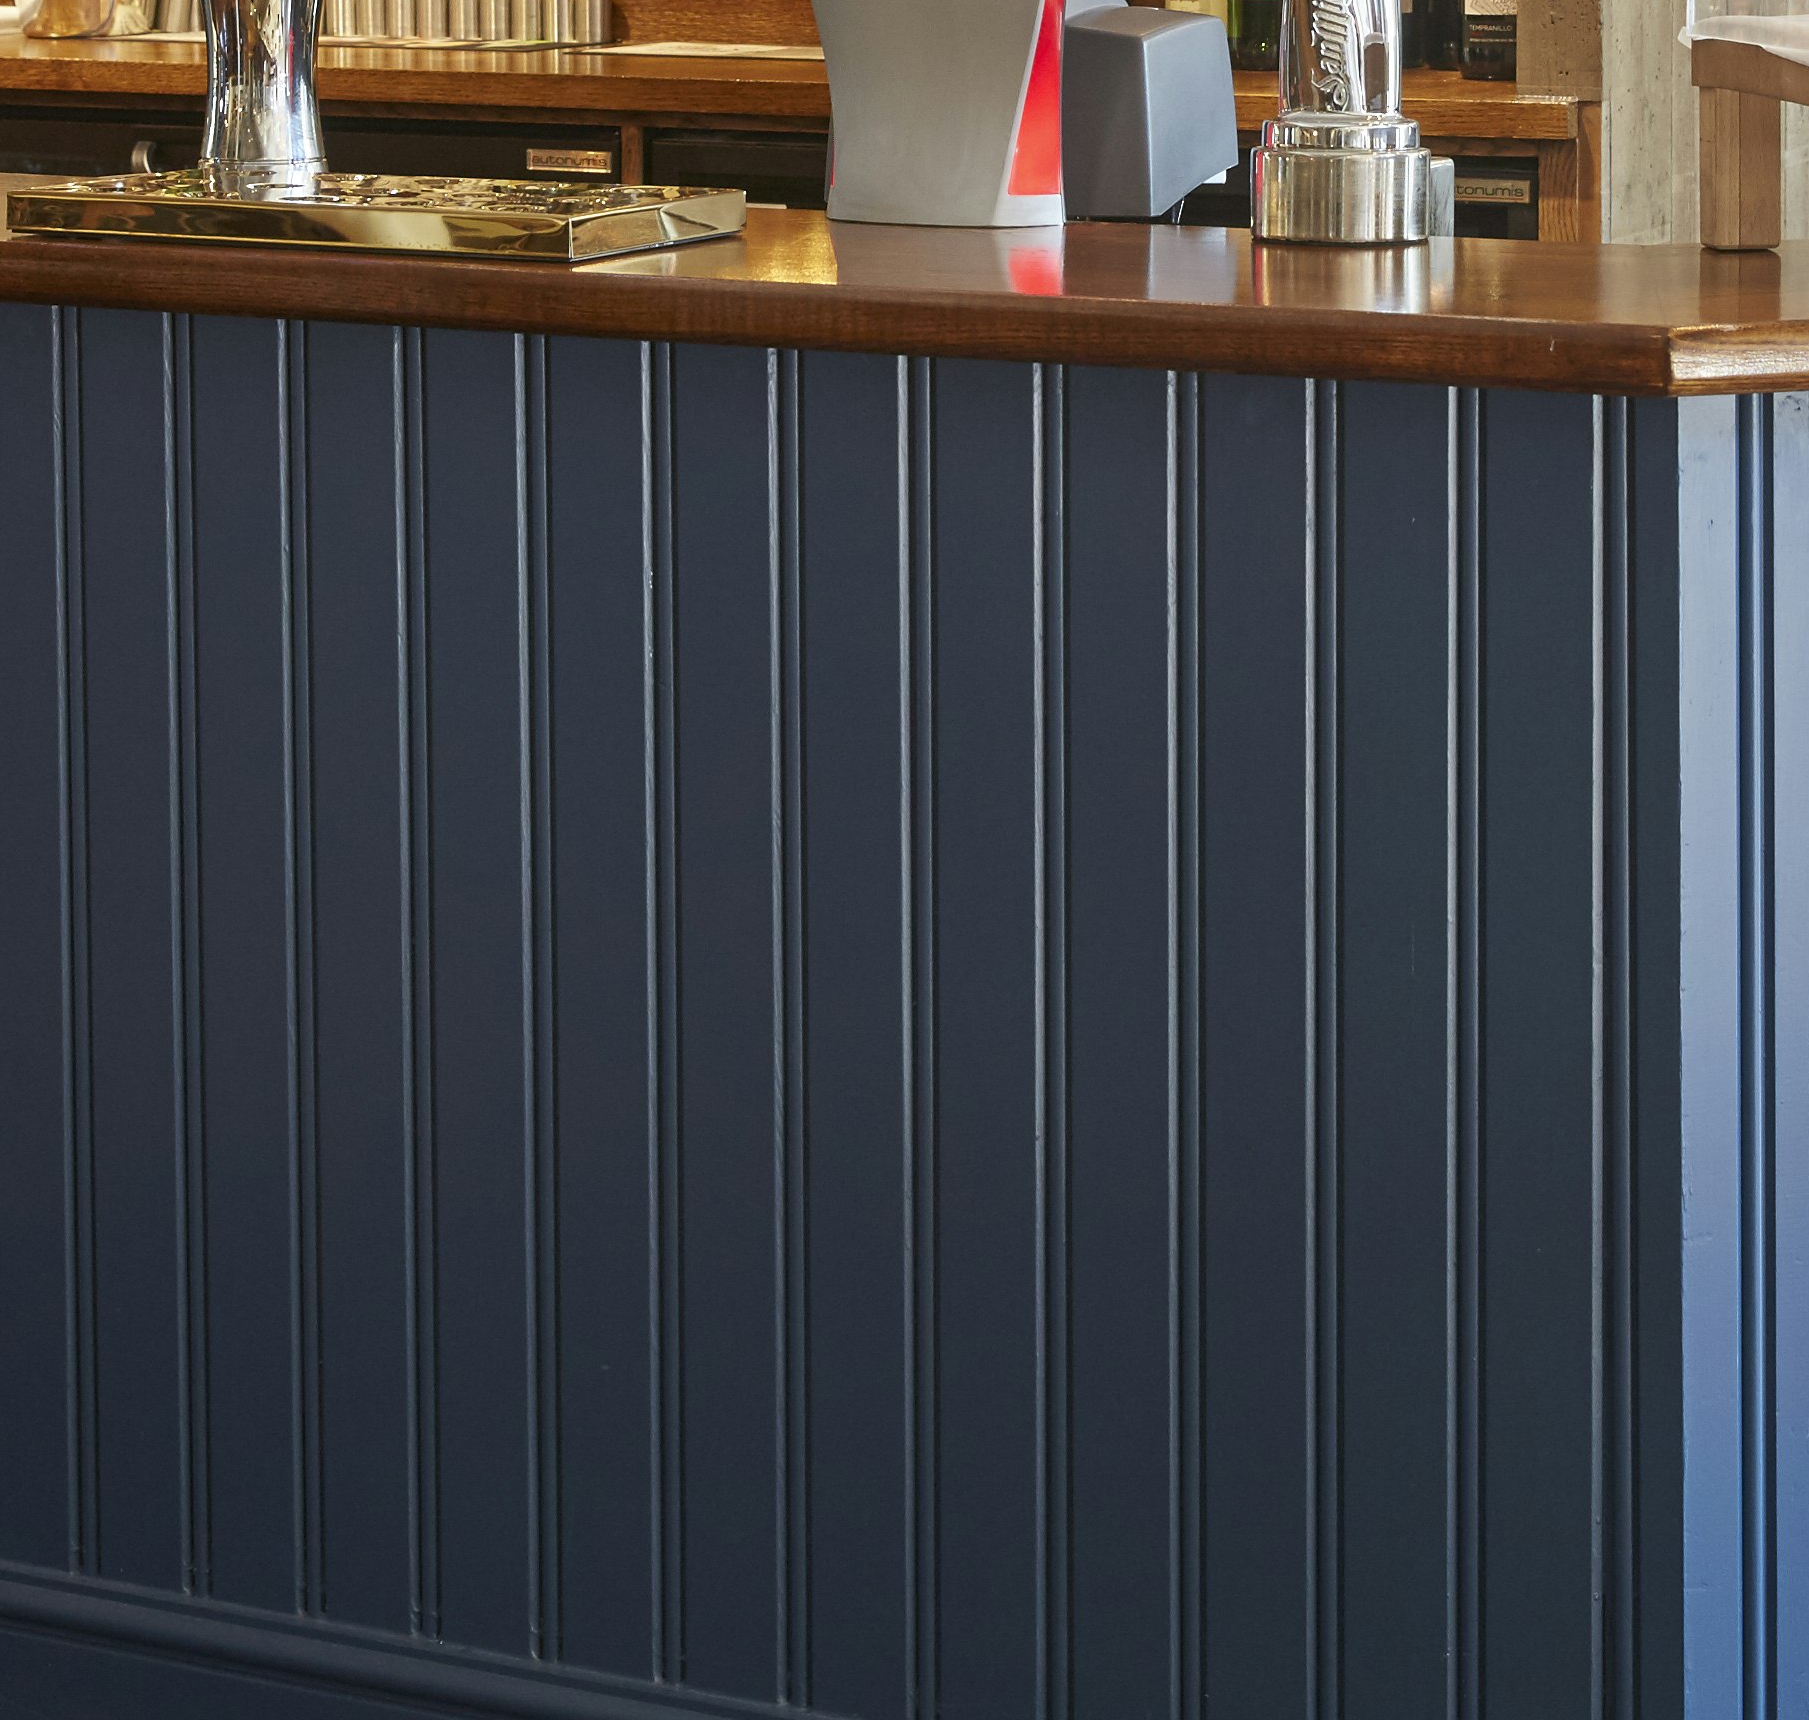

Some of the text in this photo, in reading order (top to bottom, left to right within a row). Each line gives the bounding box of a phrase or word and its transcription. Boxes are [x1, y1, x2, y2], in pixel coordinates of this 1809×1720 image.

[1469, 24, 1512, 32] TEMPRANILLO
[531, 154, 608, 167] autonumis
[1455, 183, 1524, 197] tonumis
